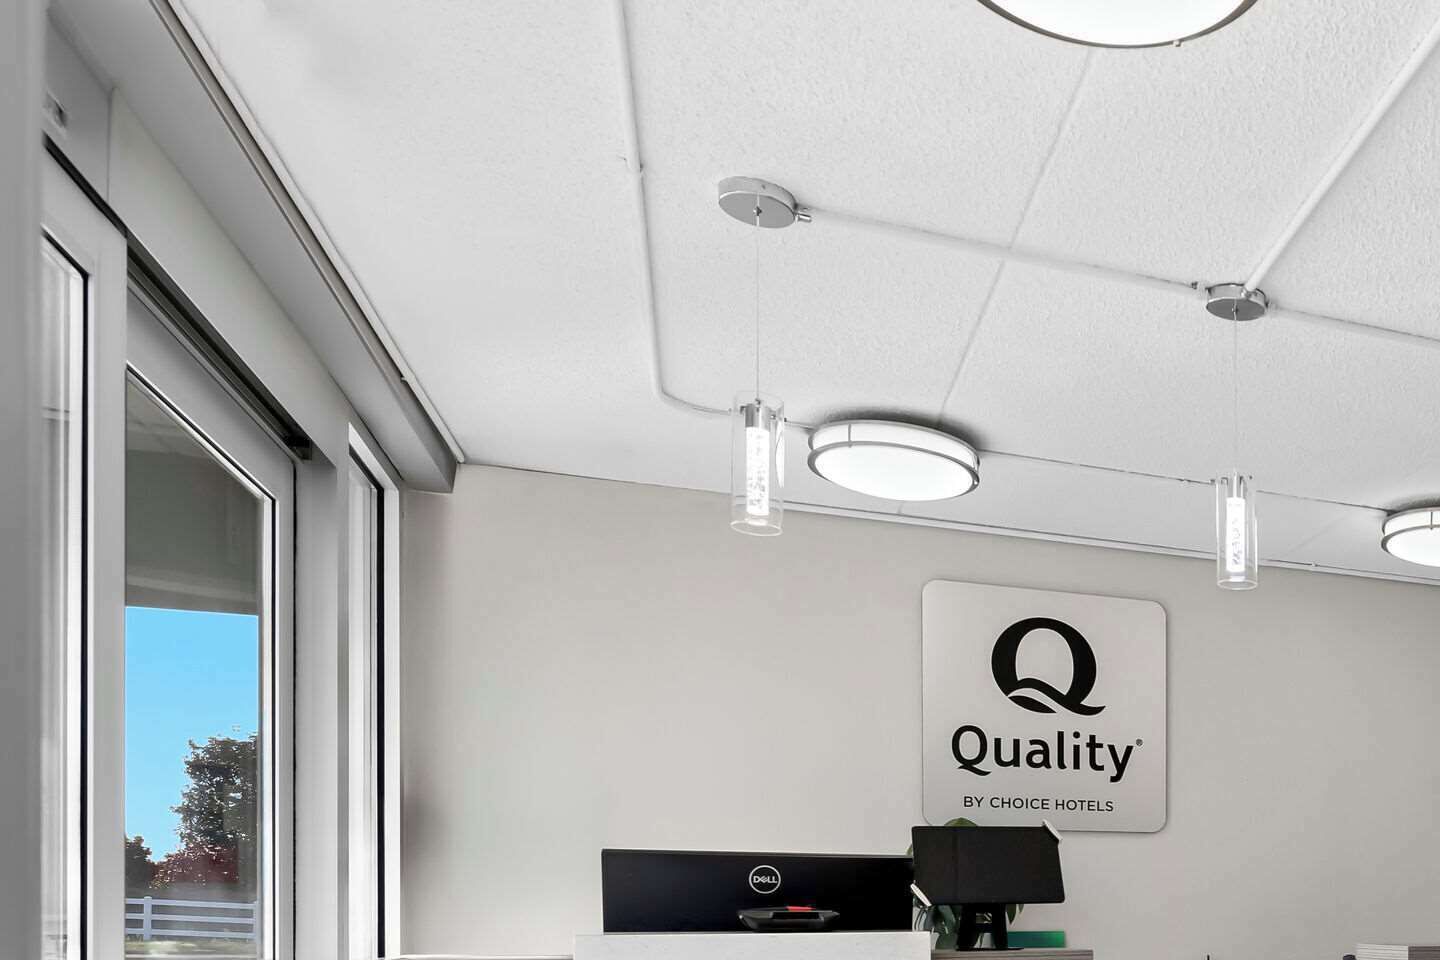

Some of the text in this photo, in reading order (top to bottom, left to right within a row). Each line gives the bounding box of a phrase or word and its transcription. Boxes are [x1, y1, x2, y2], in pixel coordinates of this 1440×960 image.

[991, 616, 1106, 716] Q
[951, 724, 1134, 783] Quality
[963, 796, 1114, 812] BY CHOICE HOTELS
[753, 875, 778, 884] DELL
